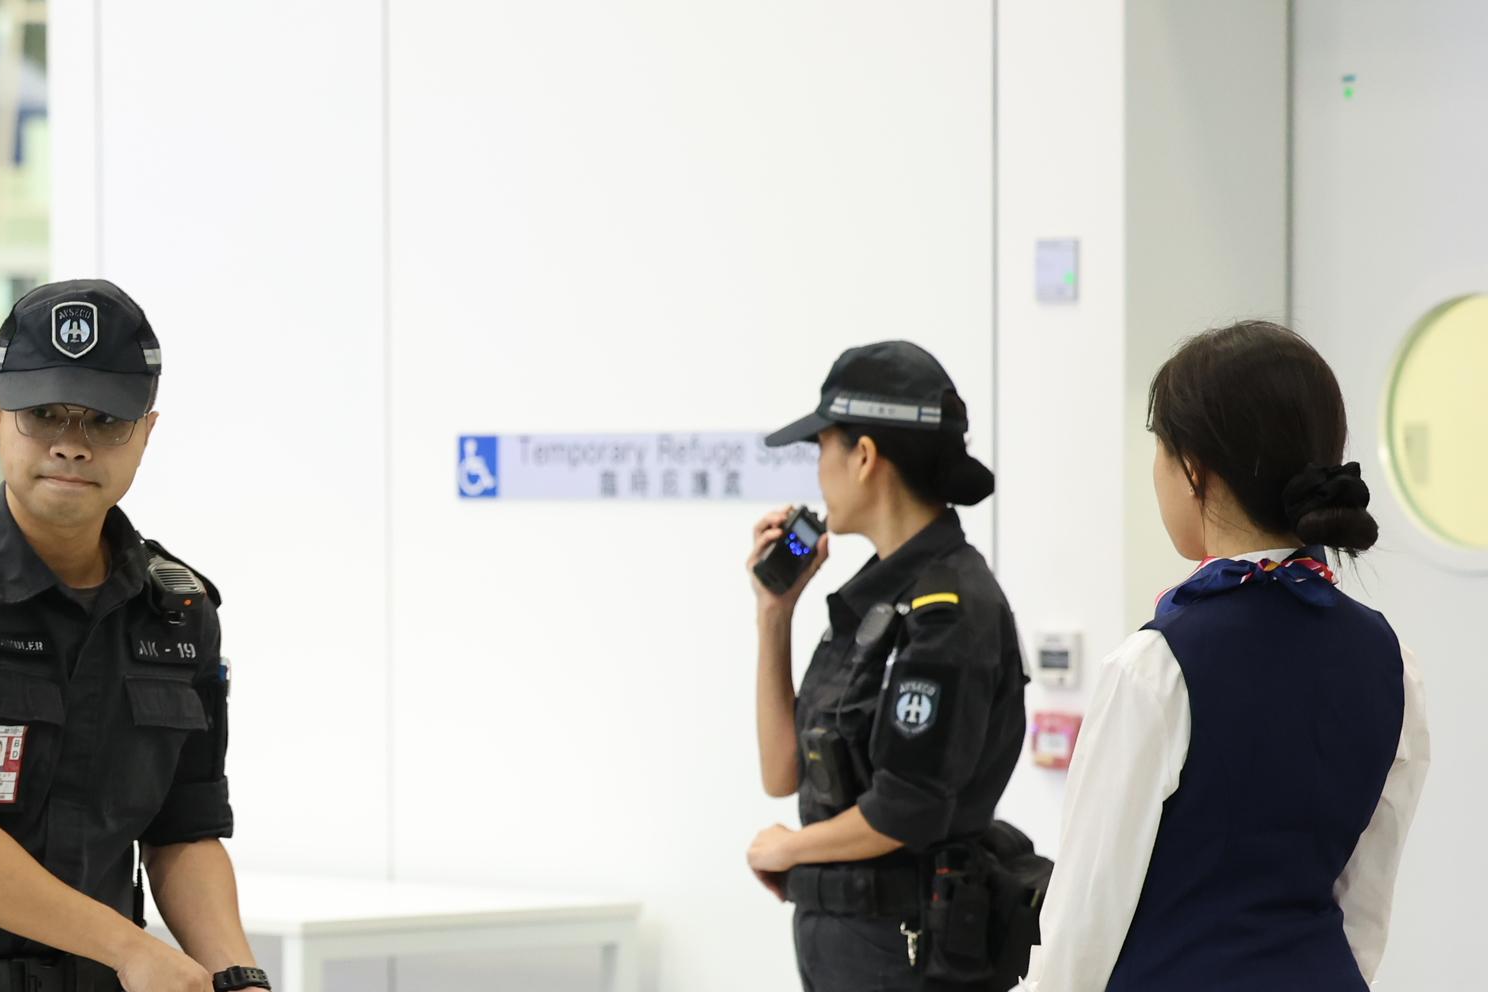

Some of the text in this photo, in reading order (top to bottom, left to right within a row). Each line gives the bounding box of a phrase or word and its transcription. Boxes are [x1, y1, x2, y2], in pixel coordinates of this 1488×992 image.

[518, 435, 820, 469] Temporary Refuge Spac
